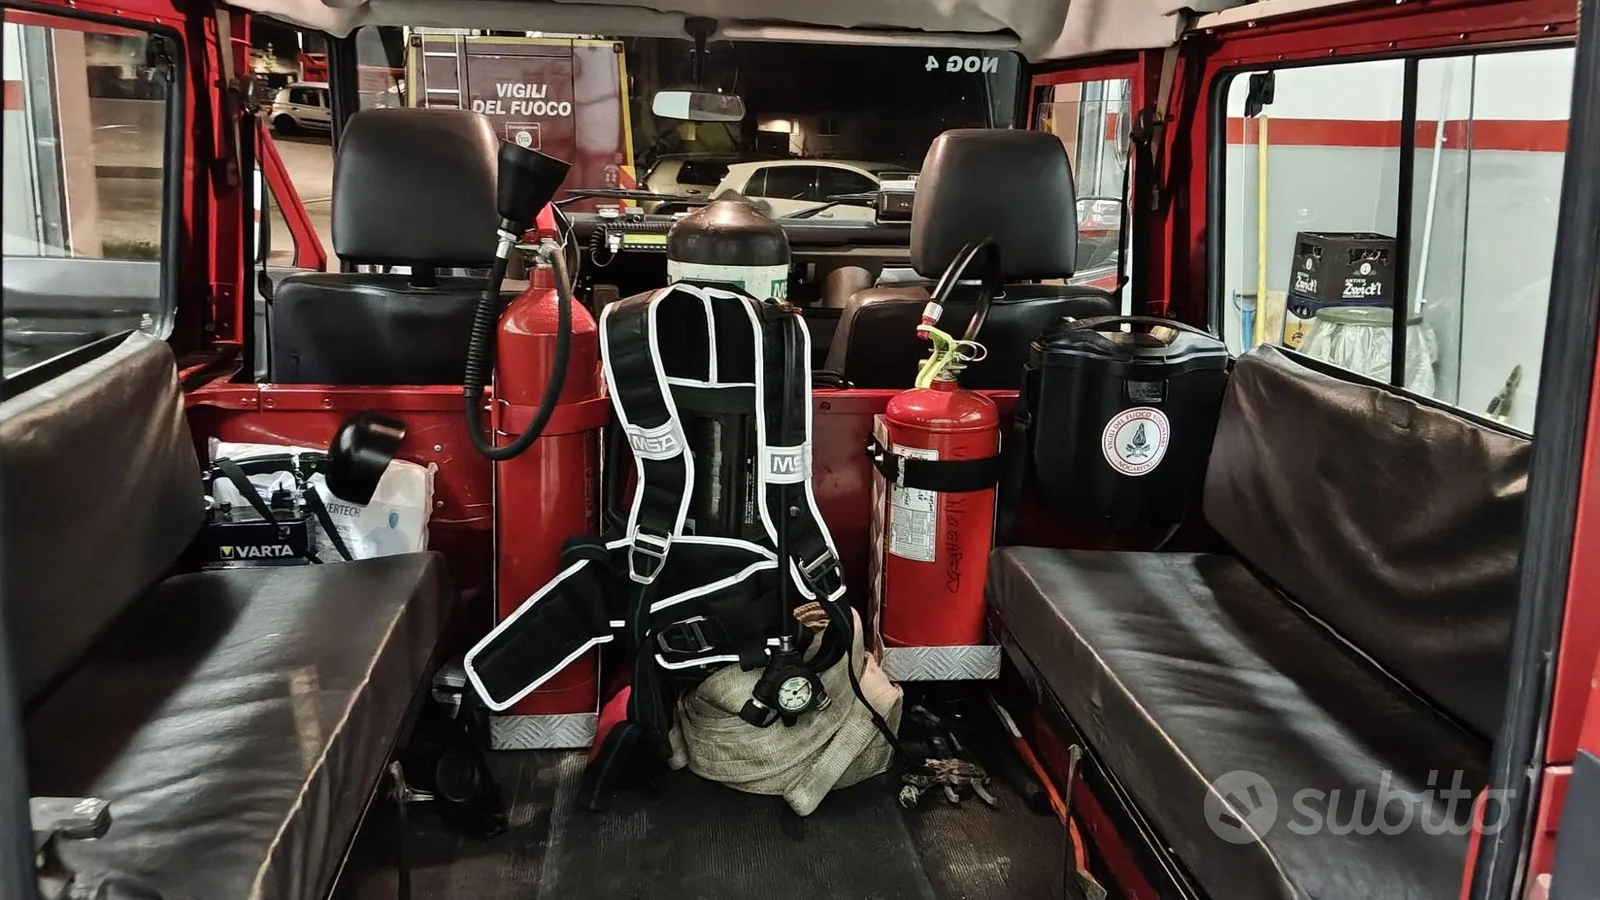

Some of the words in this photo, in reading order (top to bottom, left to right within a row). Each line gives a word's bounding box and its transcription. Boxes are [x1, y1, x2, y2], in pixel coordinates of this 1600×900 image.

[496, 83, 547, 98] VIGILI
[472, 100, 507, 115] DEL
[510, 101, 572, 117] FUOCO
[1126, 411, 1152, 420] FUOCO
[631, 434, 678, 452] MSA
[235, 544, 294, 558] VARTA
